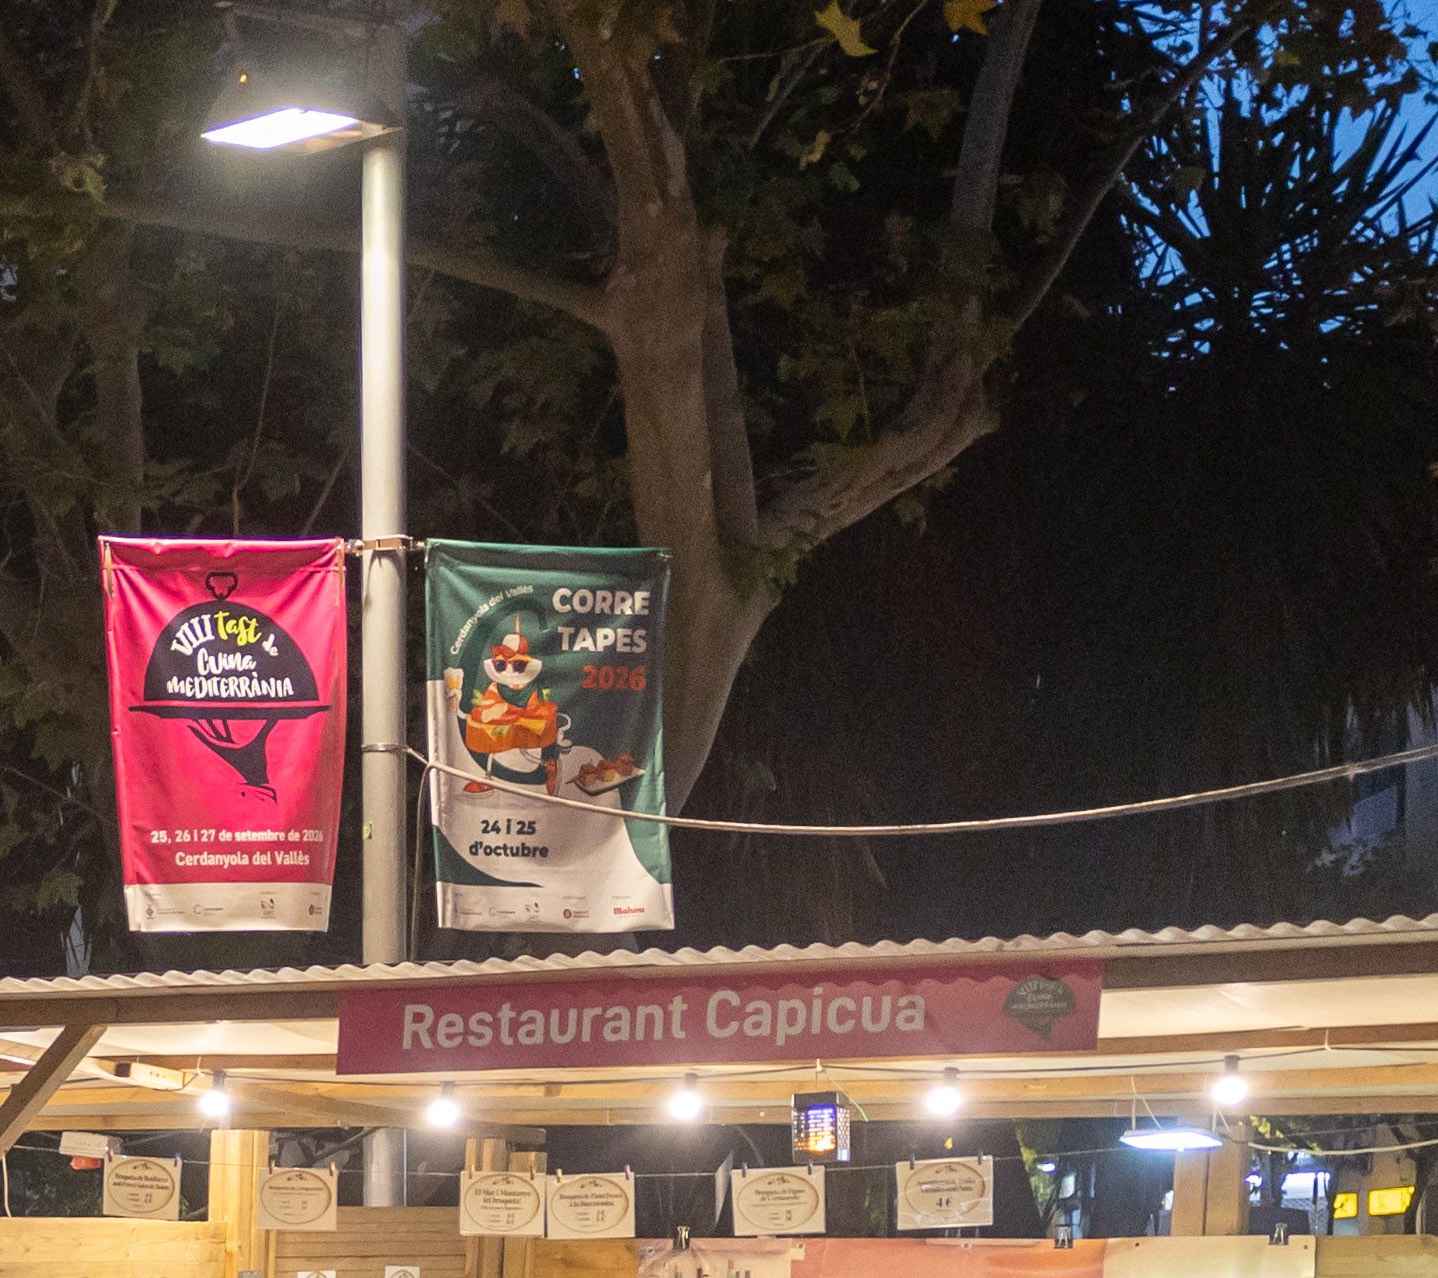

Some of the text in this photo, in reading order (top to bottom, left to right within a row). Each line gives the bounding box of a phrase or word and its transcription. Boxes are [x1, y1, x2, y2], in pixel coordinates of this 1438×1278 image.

[552, 588, 651, 615] CORRE
[170, 613, 216, 656] VIII
[450, 603, 490, 655] Cerdanyola
[488, 592, 504, 607] del
[557, 626, 647, 653] TAPES
[581, 665, 647, 692] 2026
[150, 829, 172, 845] 25,
[175, 829, 191, 843] 26
[200, 828, 216, 842] 27
[218, 828, 233, 842] de
[235, 828, 286, 842] setembre
[288, 827, 300, 841] de
[481, 819, 537, 835] 24 i 25
[175, 850, 310, 869] Cerdanyola del Vallès
[468, 840, 549, 858] d'octubre
[402, 987, 926, 1050] Restaurant Capicua
